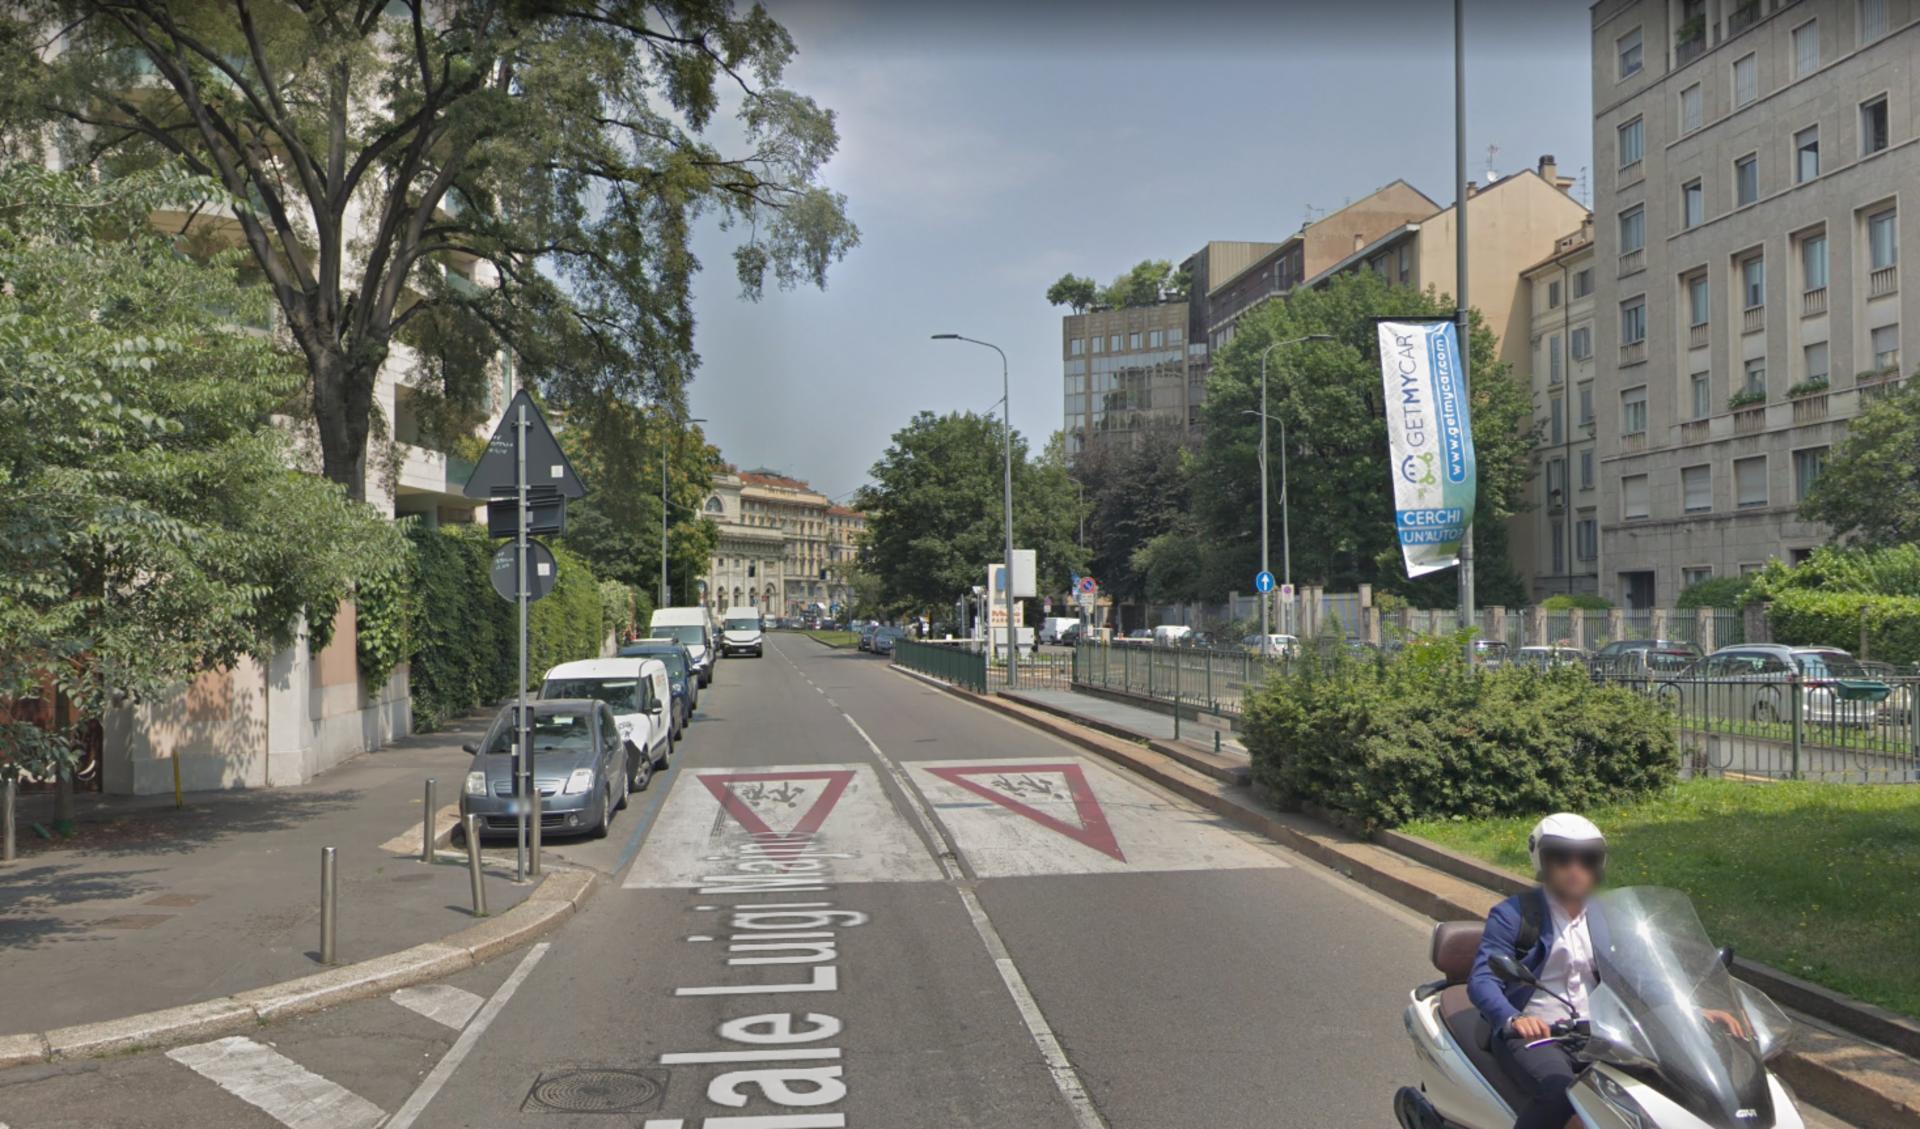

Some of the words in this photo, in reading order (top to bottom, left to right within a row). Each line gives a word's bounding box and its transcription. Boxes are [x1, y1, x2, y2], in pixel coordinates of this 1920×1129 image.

[1396, 334, 1425, 447] GETMYCAR
[1435, 339, 1461, 476] www.getmycar.com
[1403, 510, 1461, 526] CERCHI
[1404, 529, 1464, 543] UN'AUTO?
